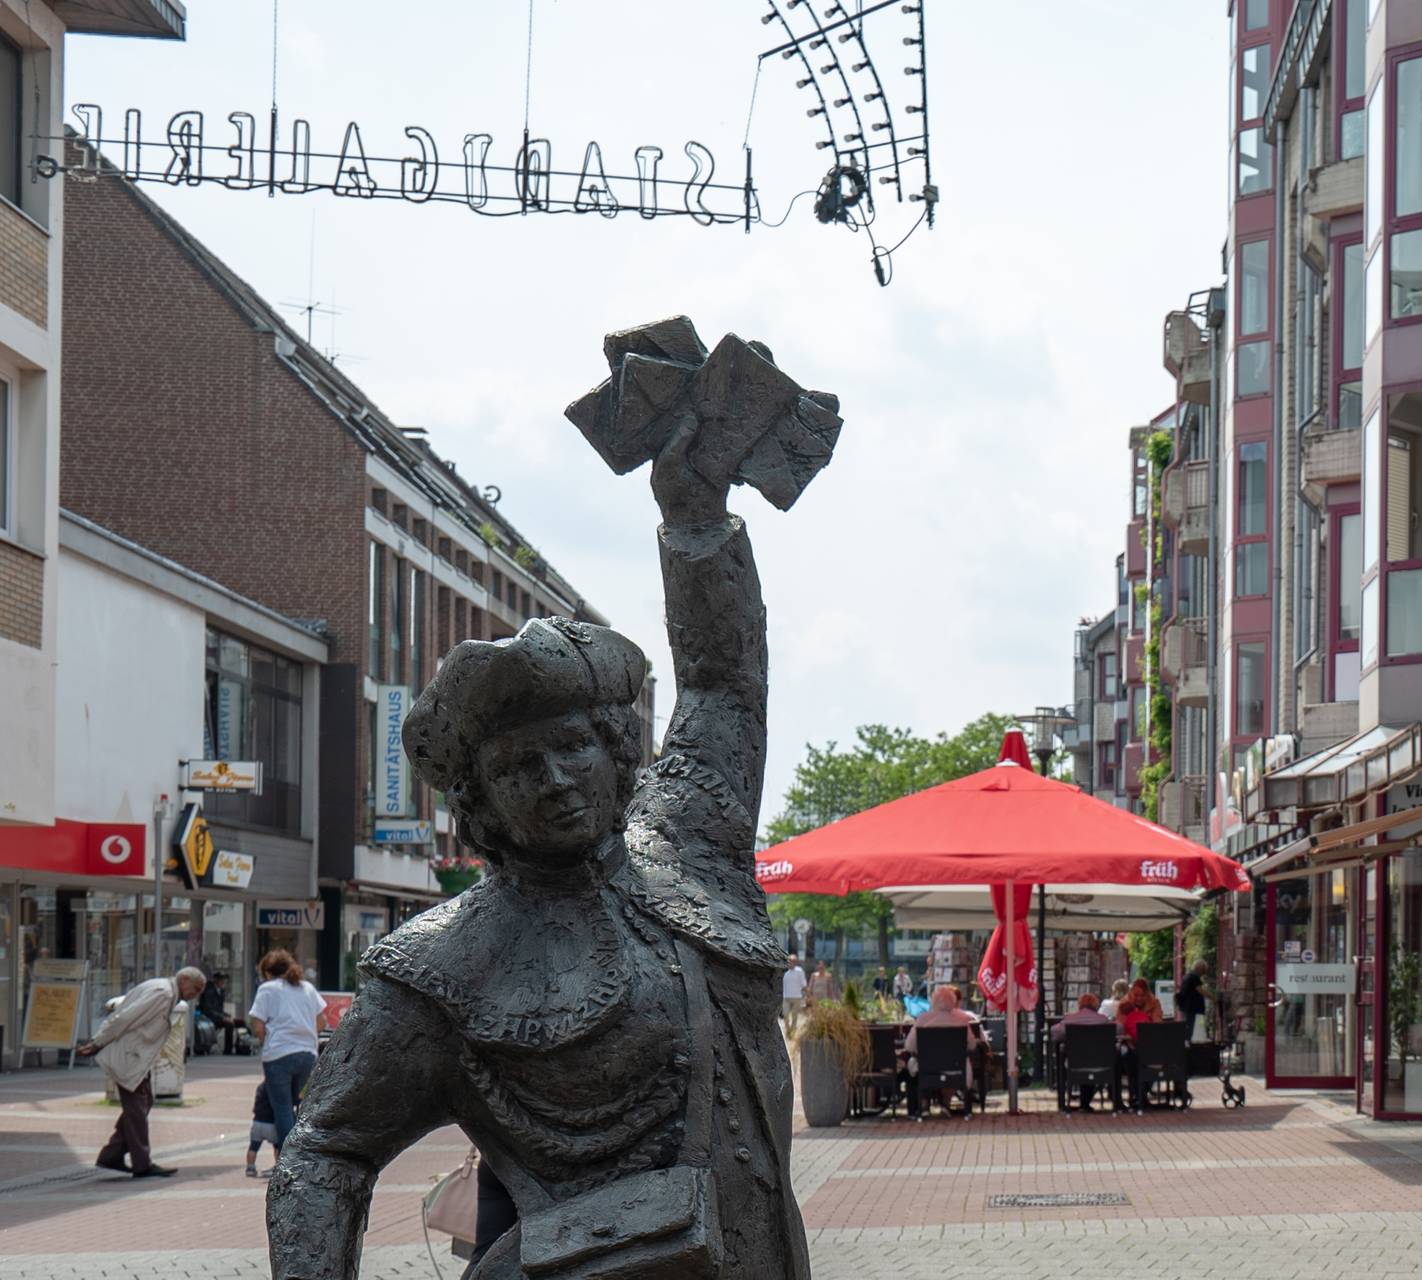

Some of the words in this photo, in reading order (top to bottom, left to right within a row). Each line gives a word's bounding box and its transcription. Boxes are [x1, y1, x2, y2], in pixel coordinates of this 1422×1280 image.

[387, 691, 401, 812] SANITÄTSHAUS
[385, 829, 413, 841] vital
[1141, 860, 1178, 878] früh
[267, 909, 302, 925] vital
